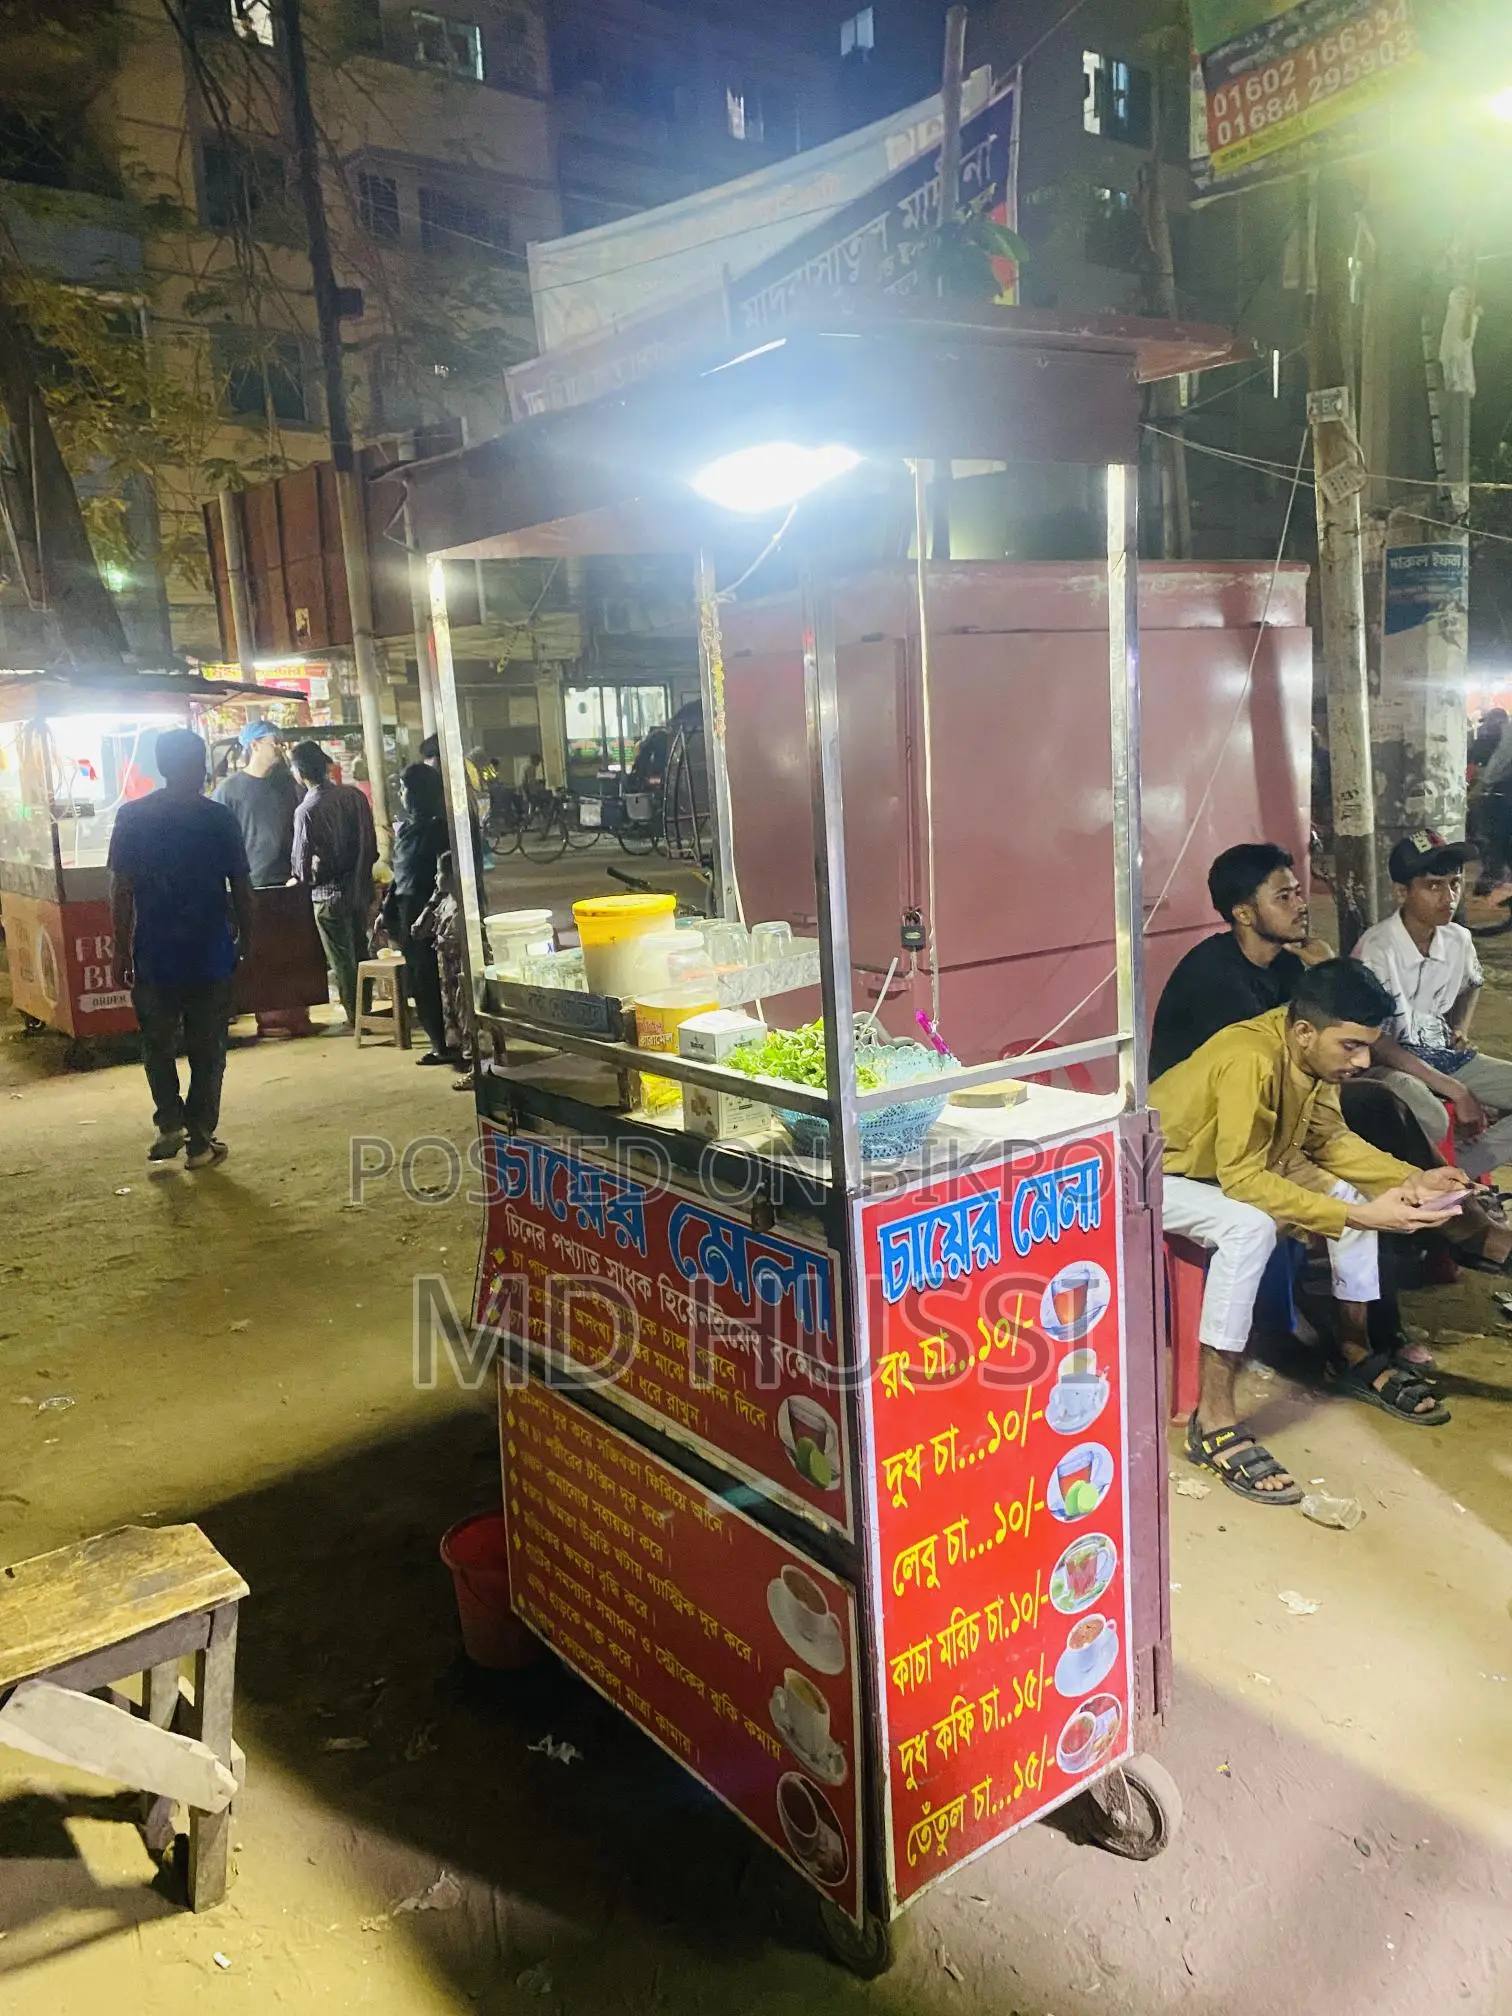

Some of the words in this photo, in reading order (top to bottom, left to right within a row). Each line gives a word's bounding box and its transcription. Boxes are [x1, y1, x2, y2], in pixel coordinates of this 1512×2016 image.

[1213, 60, 1295, 118] 01602
[1217, 89, 1299, 145] 01684
[491, 1130, 647, 1258] চায়ের
[668, 1200, 832, 1340] মেলা
[877, 1190, 1001, 1303] চায়ের
[1010, 1158, 1102, 1257] মেলা
[511, 1250, 524, 1271] চা
[505, 1203, 546, 1250] চিনের
[604, 1257, 652, 1302] সাধক
[771, 1338, 834, 1395] বলেন
[877, 1349, 917, 1399] রং
[882, 1442, 926, 1509] দুধ
[641, 1500, 666, 1529] করে
[639, 1532, 663, 1562] করে
[892, 1532, 941, 1597] লেবু
[624, 1589, 648, 1619] করে
[608, 1638, 632, 1668] করে
[699, 1610, 718, 1639] দূর
[723, 1627, 752, 1661] করে
[889, 1633, 933, 1697] কাচা
[935, 1606, 982, 1670] মরিচ
[897, 1729, 928, 1792] দুধ
[932, 1694, 977, 1760] কফি
[906, 1793, 967, 1868] তেঁতুল
